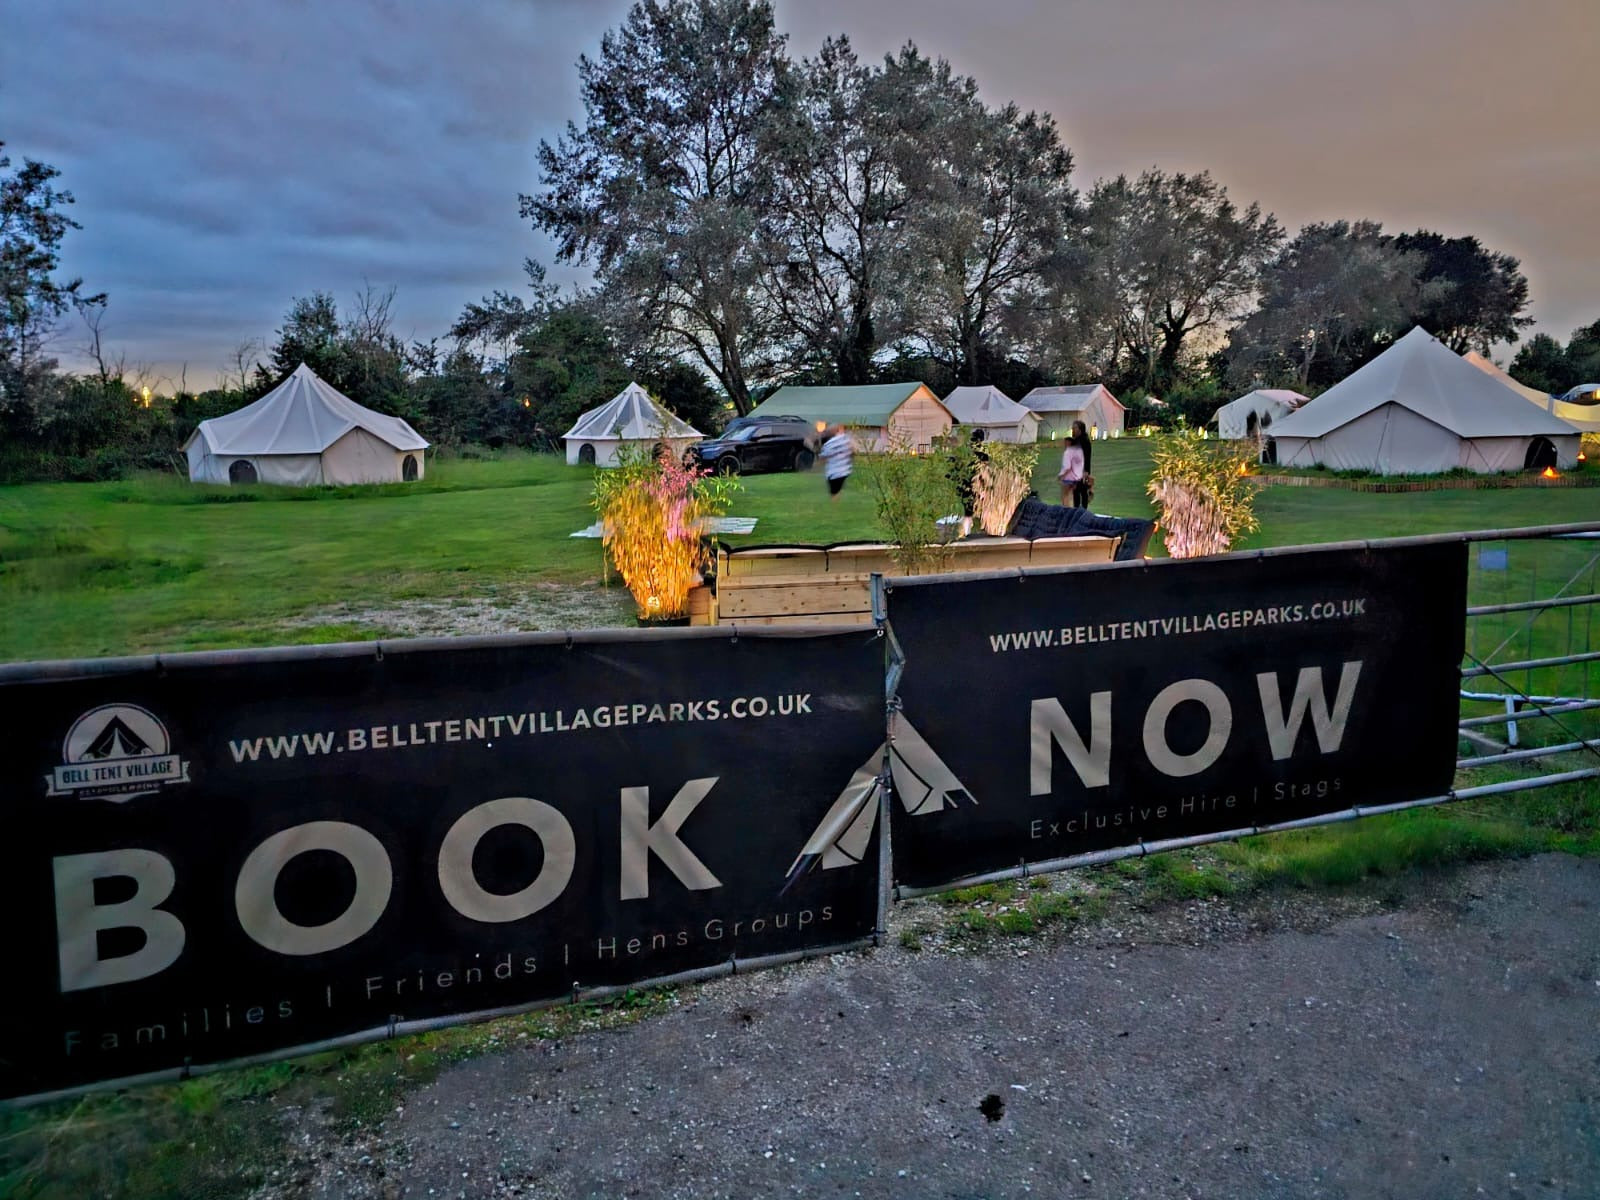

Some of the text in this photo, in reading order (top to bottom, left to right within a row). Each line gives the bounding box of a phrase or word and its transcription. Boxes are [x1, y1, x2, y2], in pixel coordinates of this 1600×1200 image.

[989, 598, 1366, 653] WWW.BELLTENTVILLAGEPARKS.CO.UK
[229, 693, 812, 763] WWW.BELLTENTVILLAGEPARKS.CO.UK
[1030, 660, 1363, 796] NOW
[62, 760, 173, 784] BELL TENT VILLAGE
[1030, 803, 1169, 840] Exclusive
[1180, 793, 1237, 817] Hire
[1273, 776, 1343, 802] Stags
[52, 776, 723, 992] BOOK
[65, 995, 294, 1057] Families
[364, 953, 538, 1001] Friends
